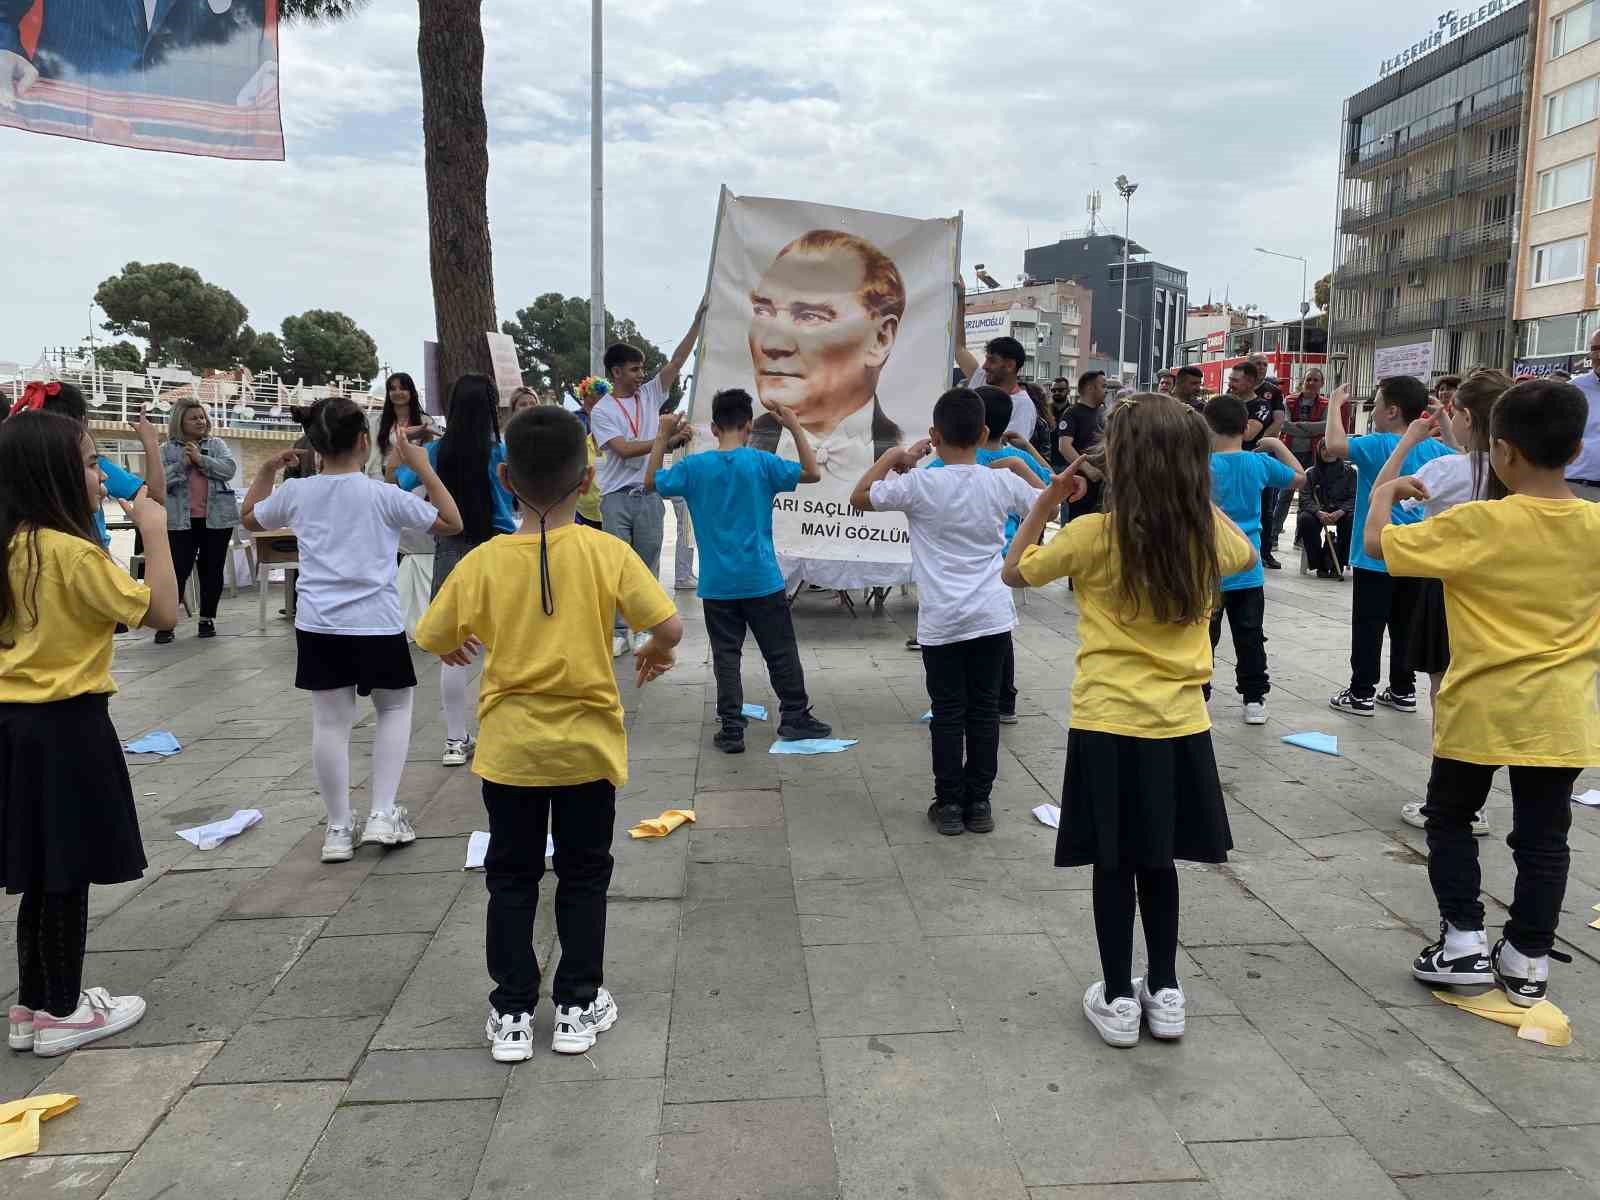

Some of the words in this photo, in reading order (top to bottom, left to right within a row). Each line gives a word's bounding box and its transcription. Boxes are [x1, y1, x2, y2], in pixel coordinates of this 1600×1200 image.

[773, 498, 798, 512] ARI
[803, 500, 864, 518] SAÇLIM
[801, 522, 841, 538] MAVİ
